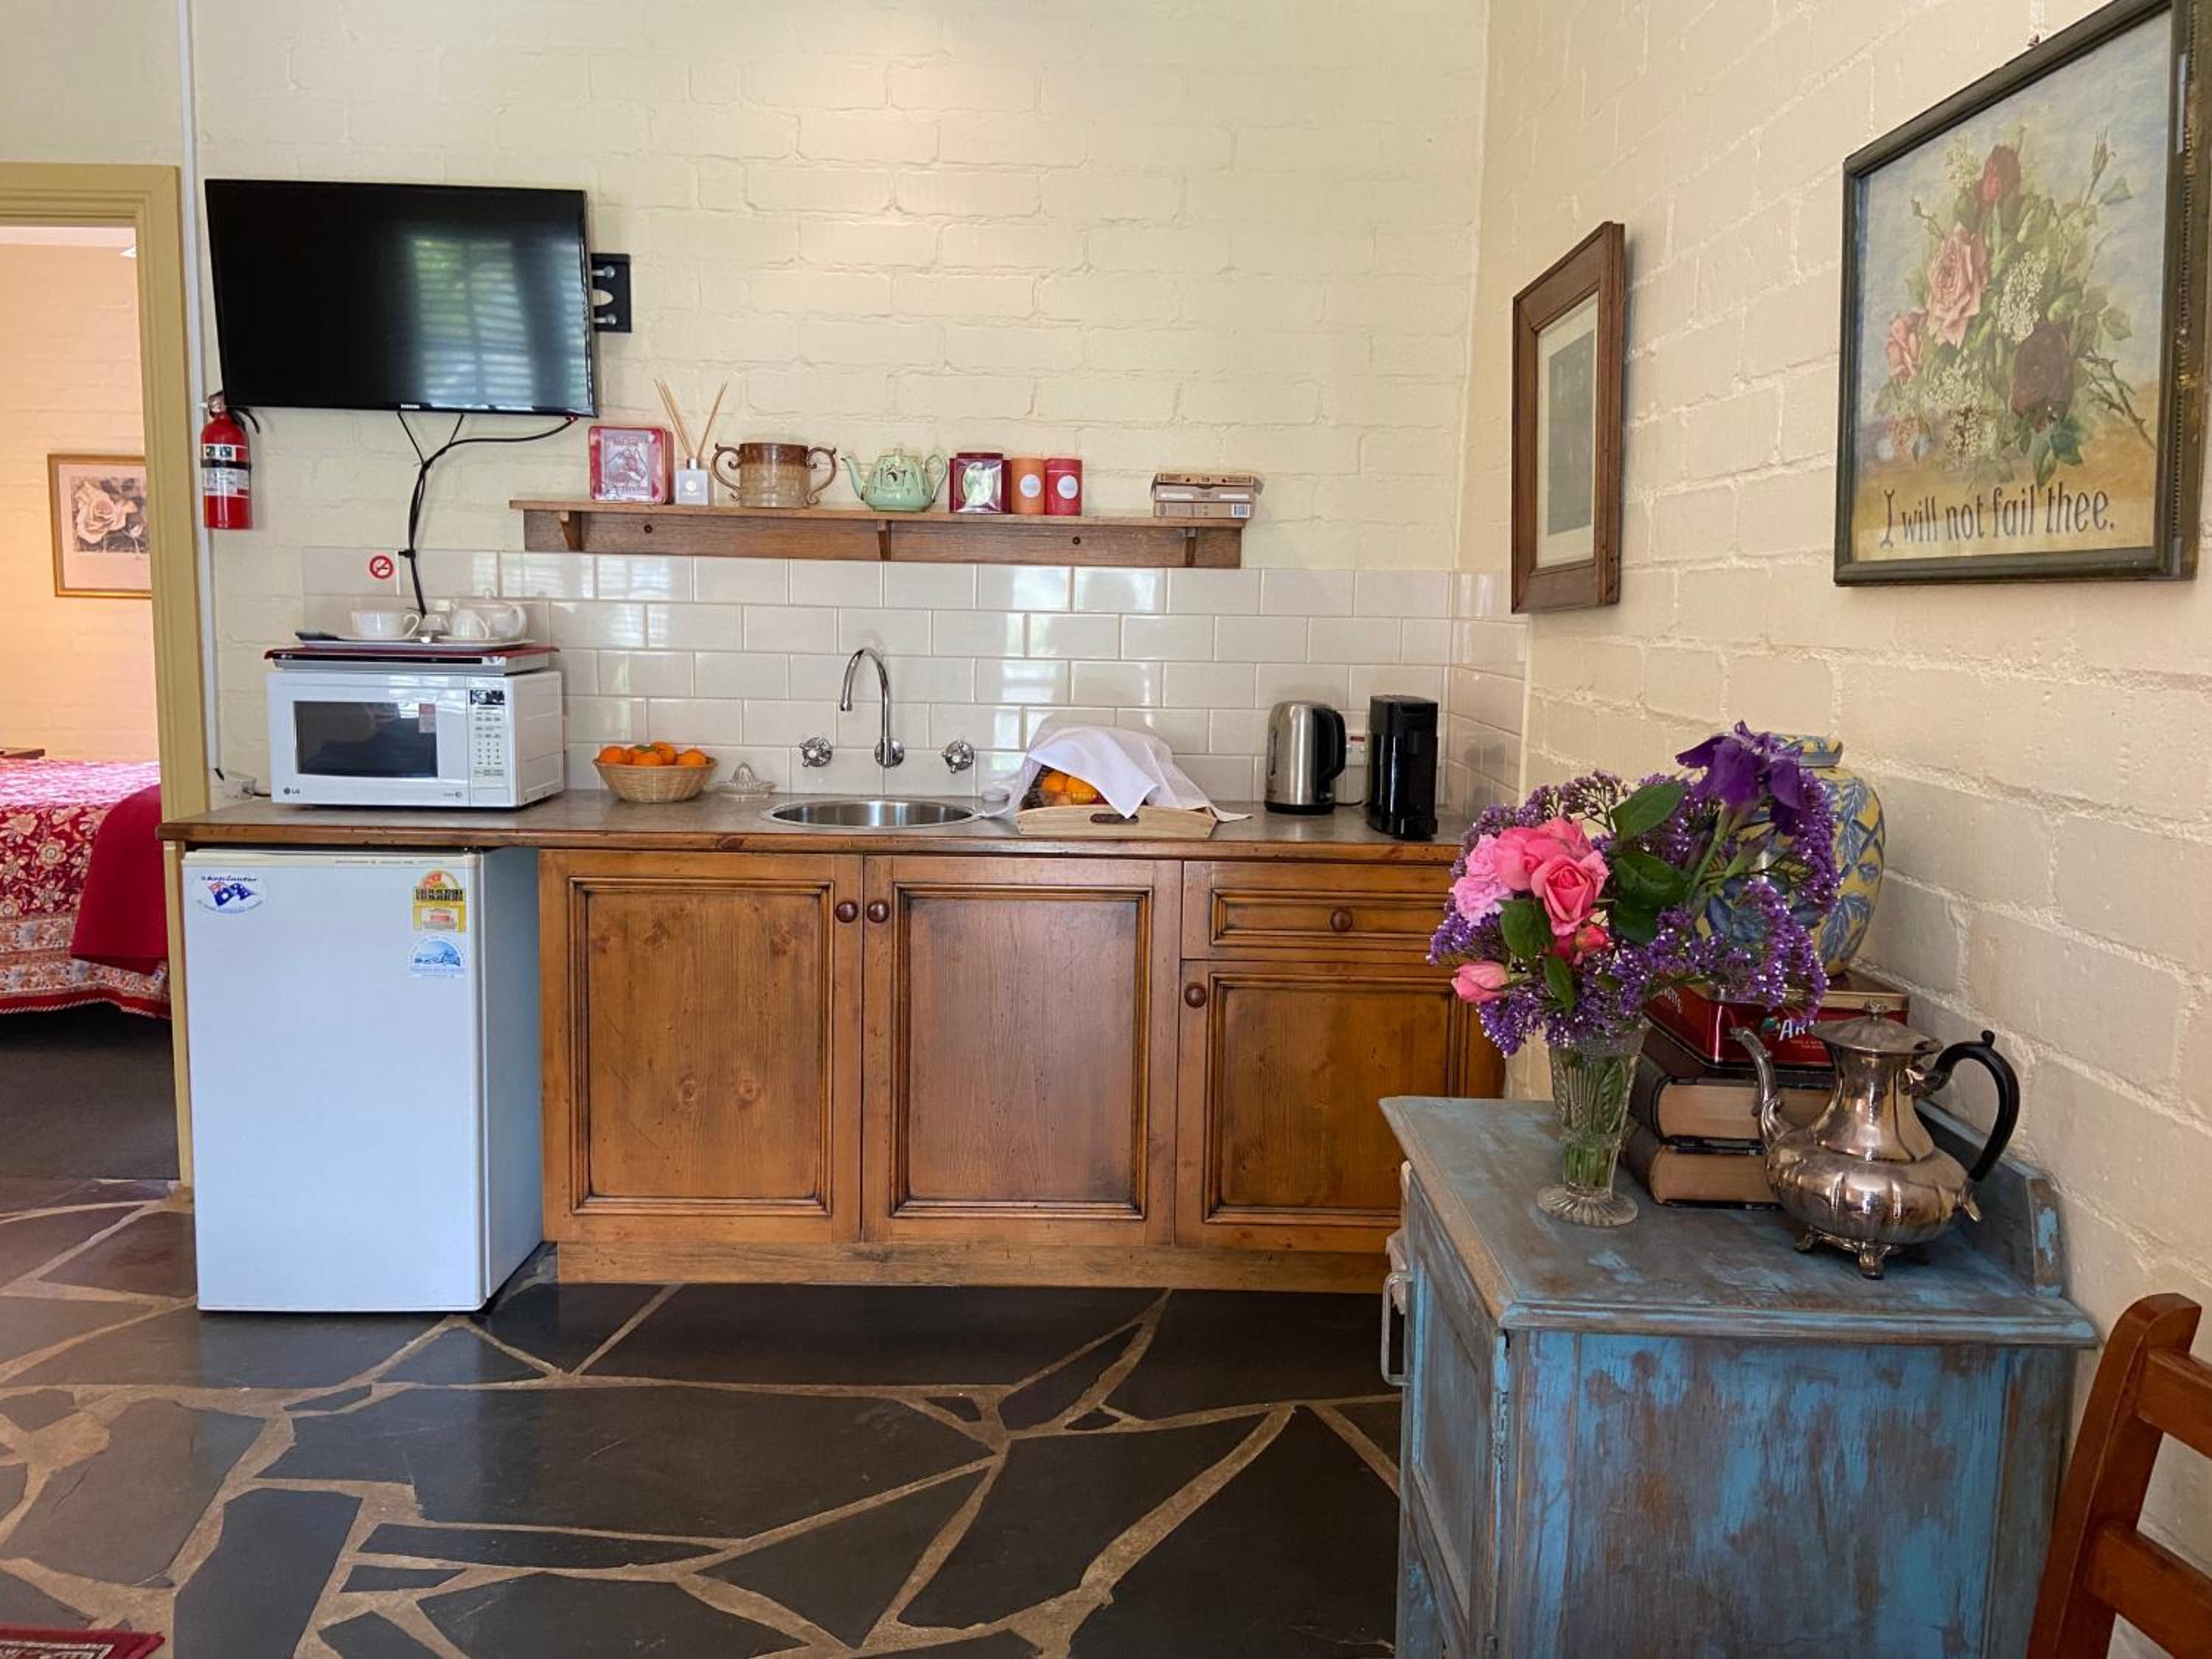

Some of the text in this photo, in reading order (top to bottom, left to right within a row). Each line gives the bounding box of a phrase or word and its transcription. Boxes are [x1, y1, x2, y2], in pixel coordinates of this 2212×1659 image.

[1880, 481, 2115, 548] I will not fail thee.
